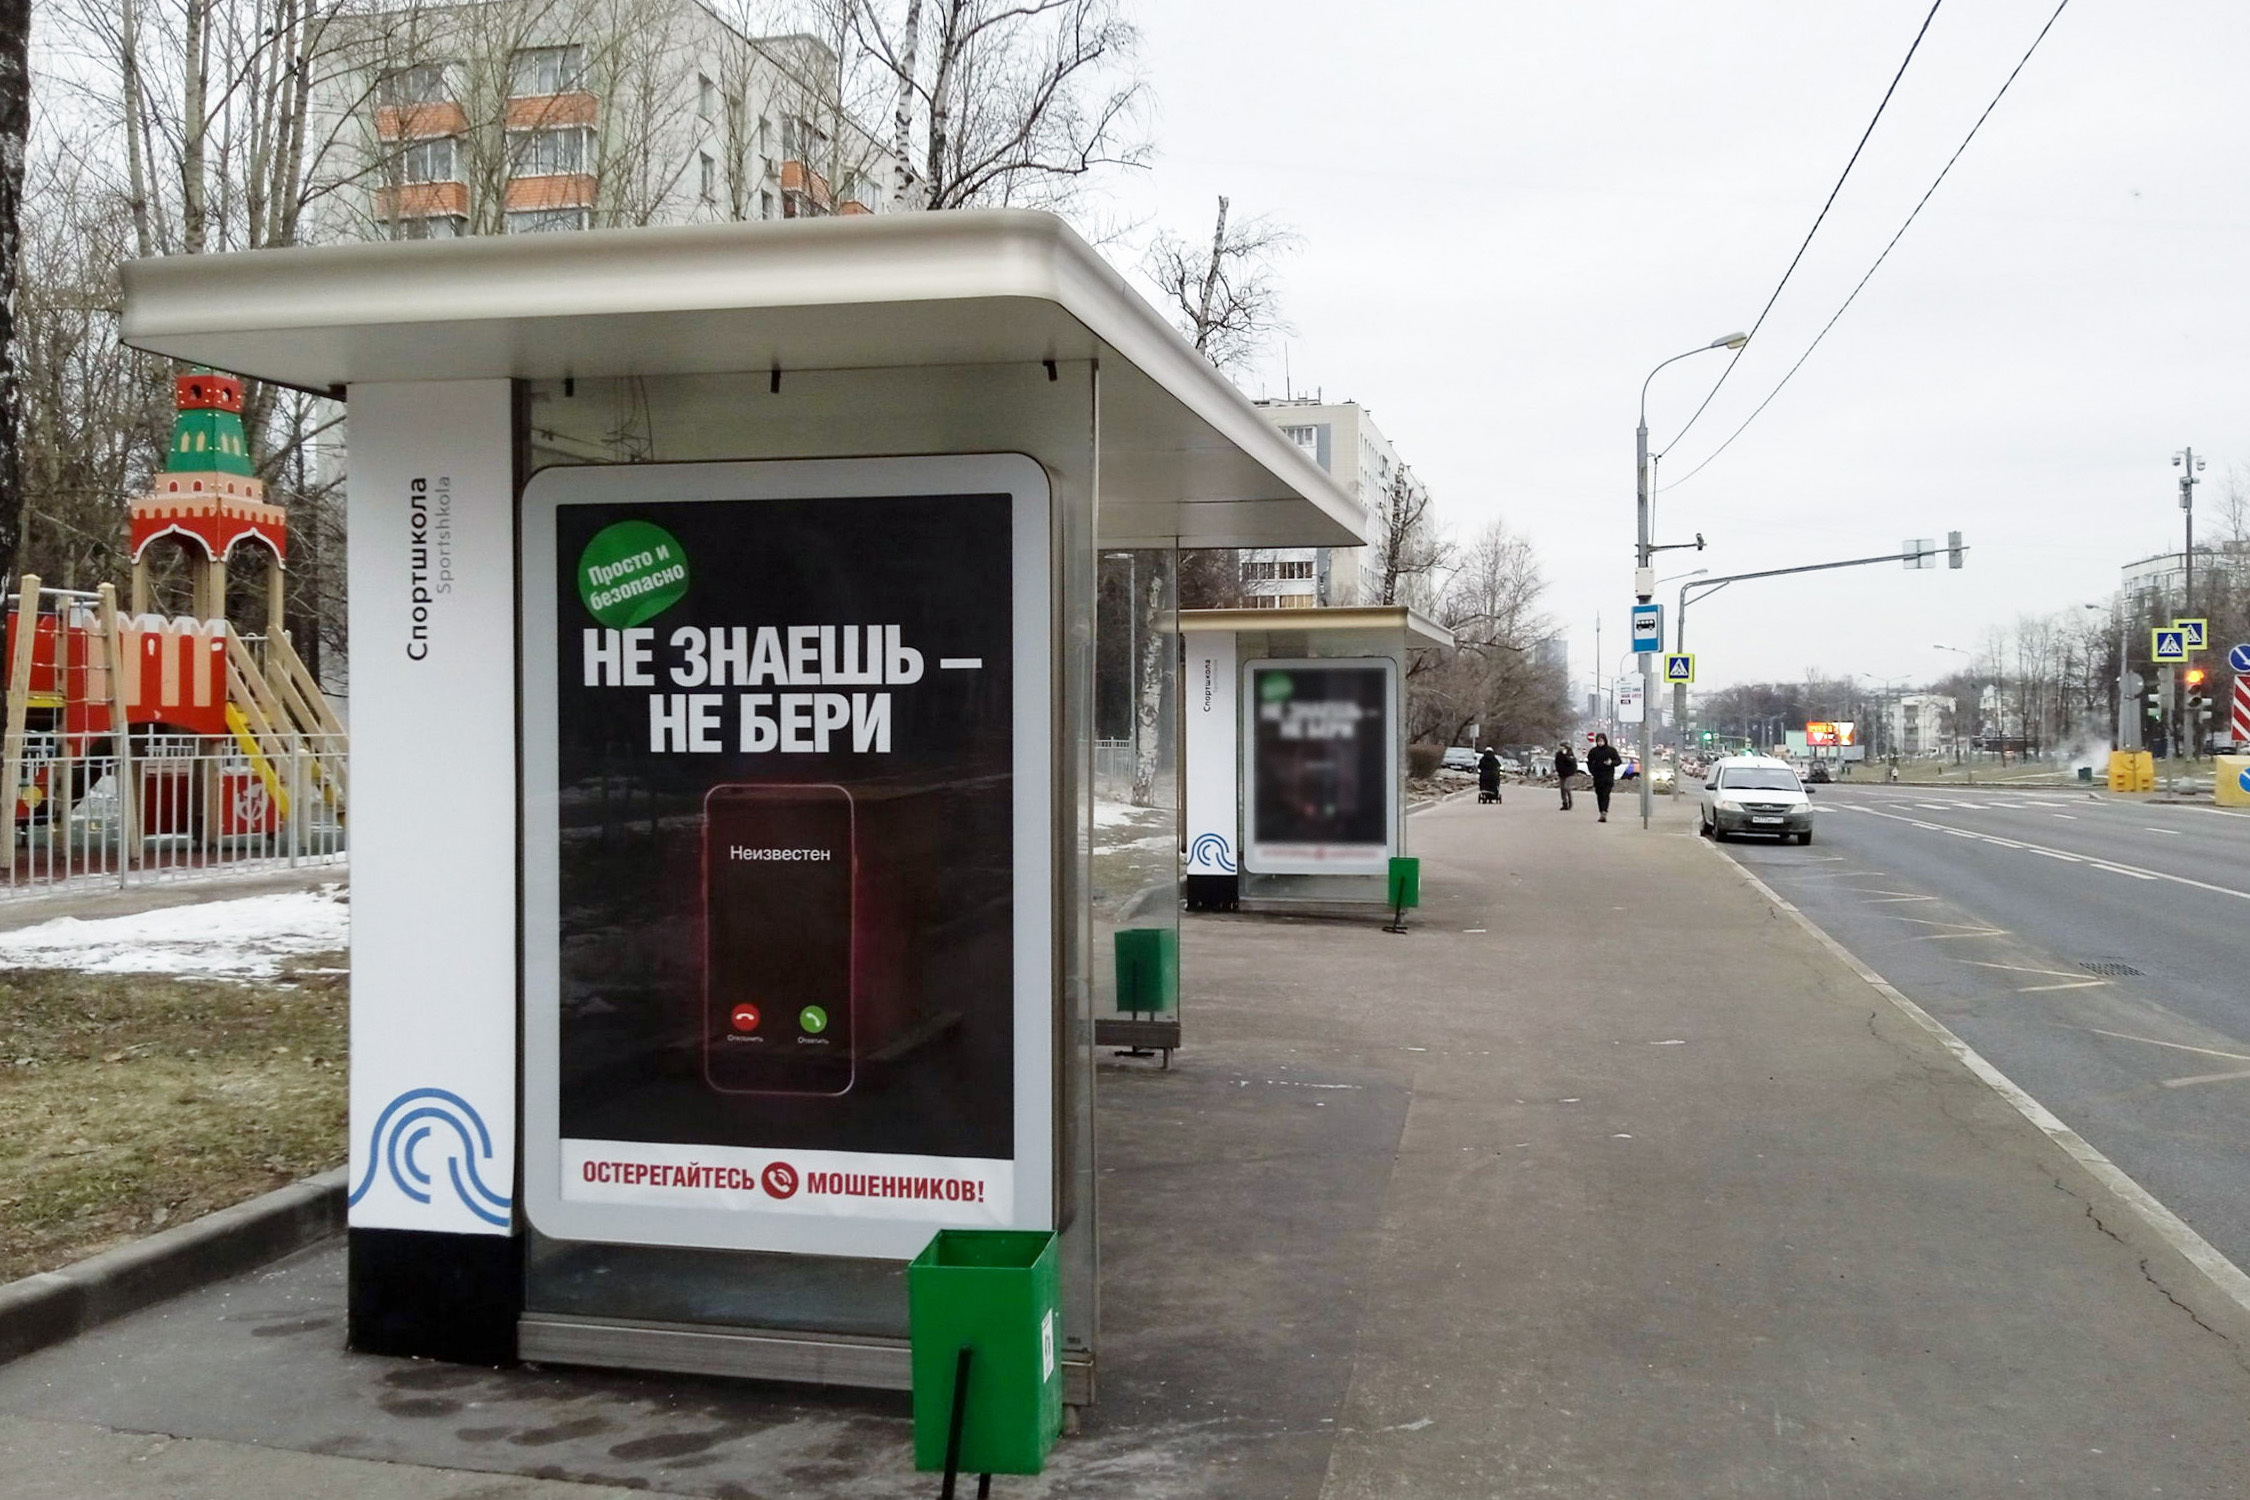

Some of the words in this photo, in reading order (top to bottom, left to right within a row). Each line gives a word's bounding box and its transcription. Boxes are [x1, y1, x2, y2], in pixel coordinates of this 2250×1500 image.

[435, 476, 454, 594] Sportshkola
[407, 477, 433, 661] Спортшкола
[587, 551, 654, 587] Просто
[655, 544, 671, 562] и
[589, 564, 686, 611] безопасно
[583, 627, 656, 687] НЕ
[669, 624, 925, 687] ЗНАЕШЬ
[1203, 659, 1212, 713] Спортшкола
[649, 693, 723, 754] НЕ
[739, 692, 892, 754] БЕРИ
[729, 845, 832, 862] Неизвестен
[582, 1160, 755, 1191] ОСТЕРЕГАЙТЕСЬ
[807, 1172, 986, 1203] МОШЕННИКОВ!
